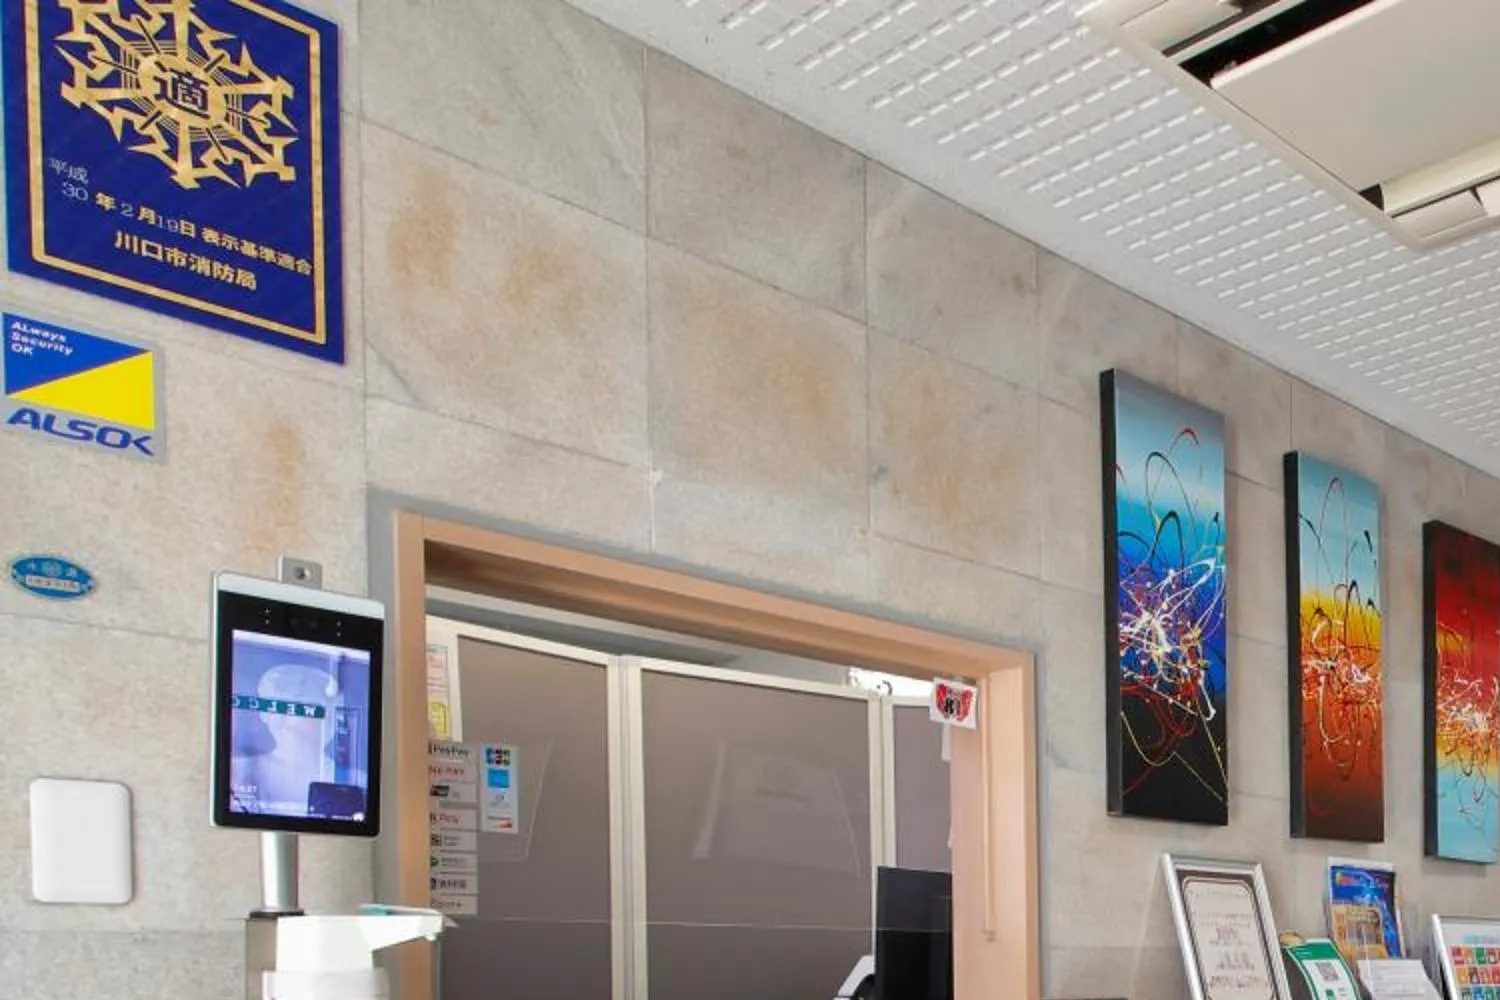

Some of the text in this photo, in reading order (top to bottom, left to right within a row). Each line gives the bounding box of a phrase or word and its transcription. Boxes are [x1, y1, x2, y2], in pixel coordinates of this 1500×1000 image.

[114, 230, 257, 291] 川口市消防局
[7, 407, 155, 457] ALSOK
